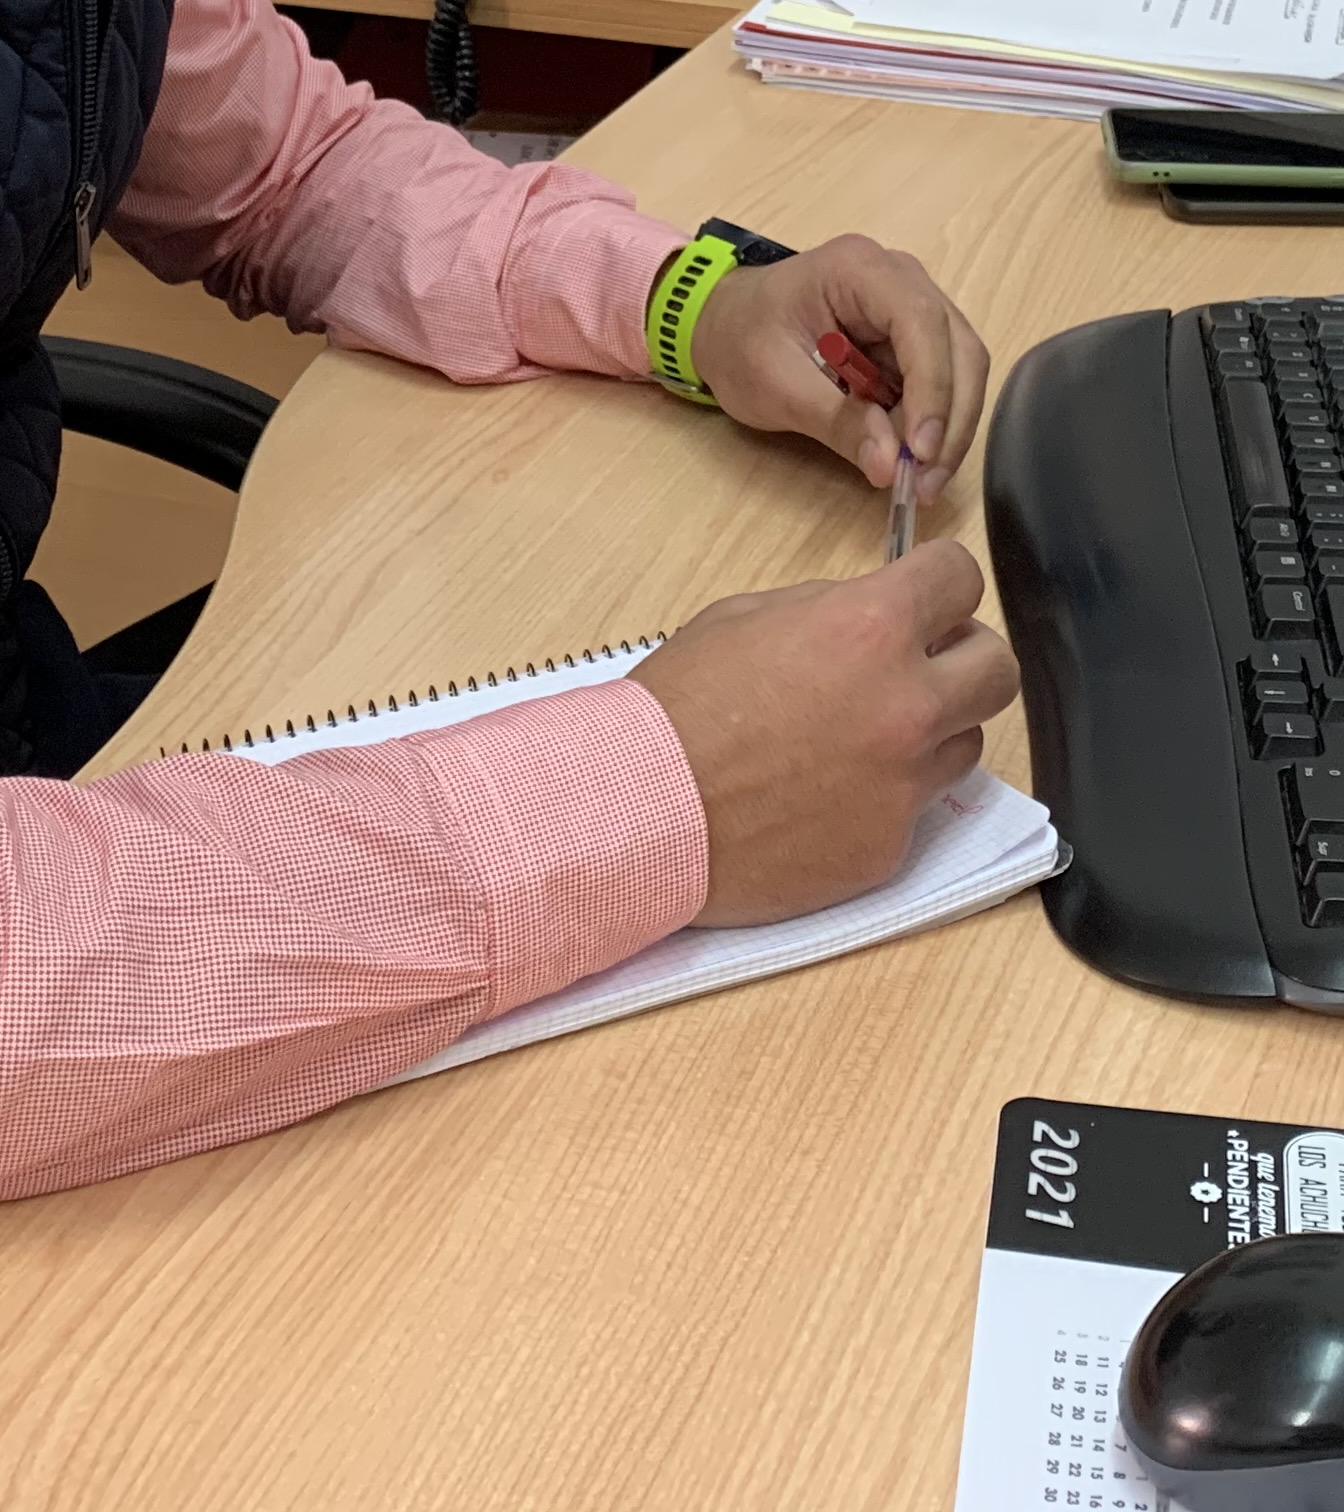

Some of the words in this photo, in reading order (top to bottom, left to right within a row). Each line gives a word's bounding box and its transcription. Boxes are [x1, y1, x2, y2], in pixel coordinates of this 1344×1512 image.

[1298, 1145, 1327, 1170] LOS
[1026, 1121, 1080, 1229] 2021
[1250, 1153, 1275, 1182] que
[1227, 1138, 1251, 1250] PENDIENTE
[1256, 1181, 1280, 1238] tenemo
[1299, 1178, 1329, 1234] ACHUCH
[1054, 1349, 1067, 1364] 25
[1075, 1353, 1088, 1367] 18
[1097, 1356, 1109, 1368] 11
[1052, 1376, 1065, 1390] 26
[1074, 1380, 1086, 1394] 19
[1095, 1383, 1108, 1397] 12
[1050, 1403, 1063, 1419] 27
[1072, 1406, 1085, 1421] 20
[1094, 1409, 1106, 1424] 13
[1048, 1431, 1061, 1446] 28
[1070, 1434, 1083, 1448] 21
[1092, 1439, 1105, 1453] 14
[1046, 1458, 1060, 1474] 29
[1069, 1462, 1082, 1477] 22
[1090, 1466, 1103, 1480] 15
[1044, 1487, 1058, 1503] 30
[1067, 1490, 1080, 1506] 23
[1089, 1494, 1102, 1509] 16
